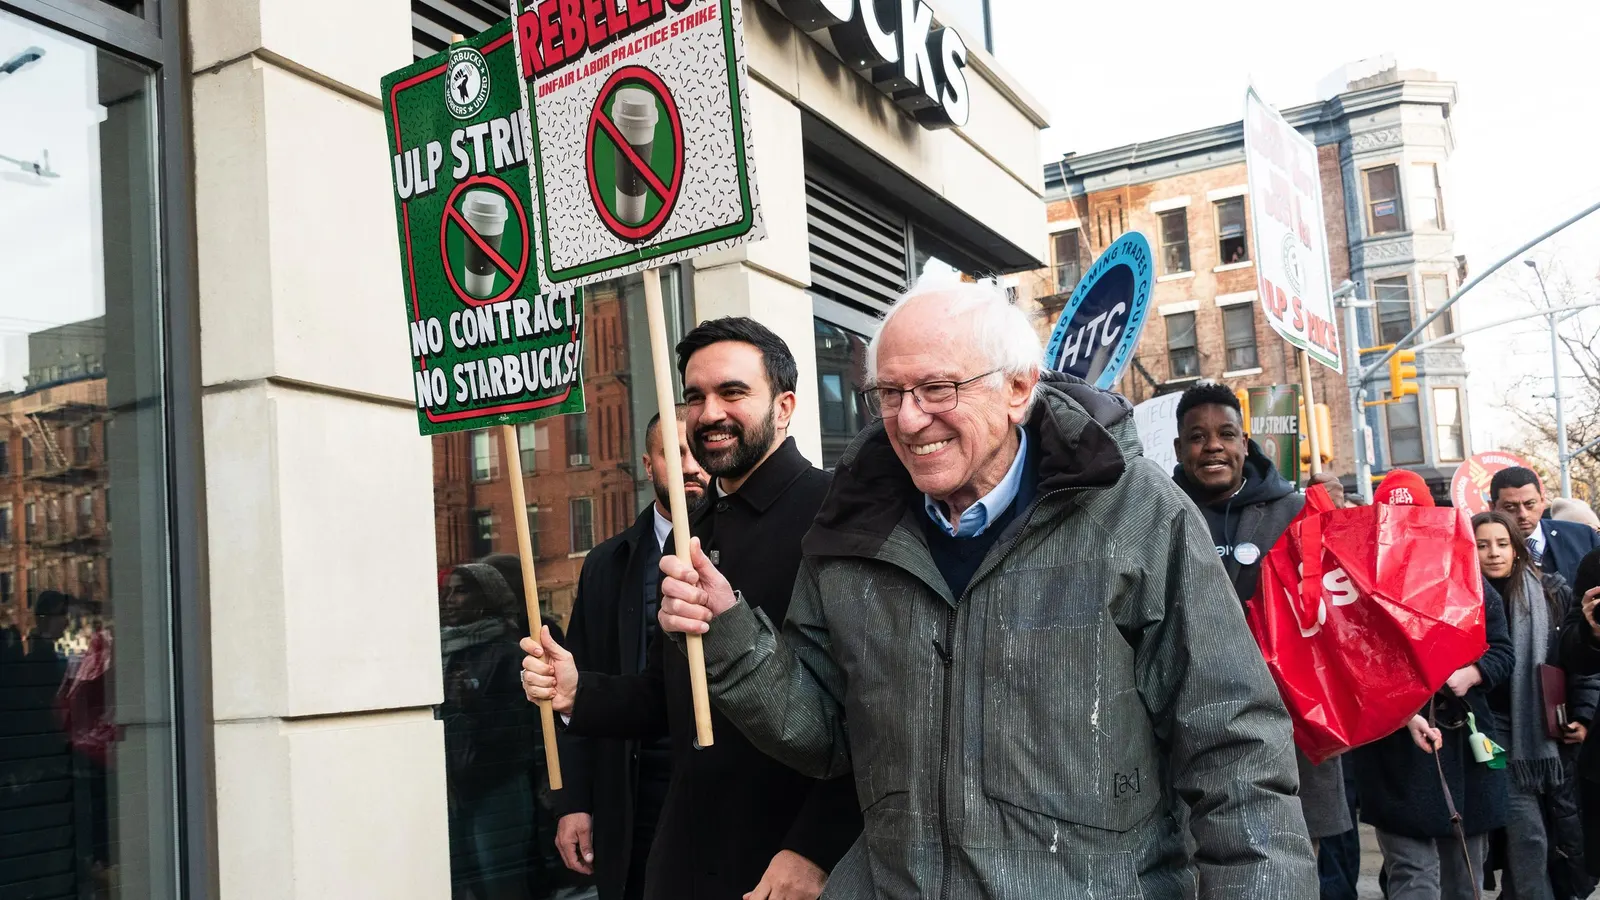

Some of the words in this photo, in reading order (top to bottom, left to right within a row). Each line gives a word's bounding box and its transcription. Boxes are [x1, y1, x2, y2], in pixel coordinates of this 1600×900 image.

[447, 51, 483, 76] STARBUCKS
[539, 70, 574, 98] UNFAIR
[576, 53, 610, 82] LABOR
[611, 27, 669, 65] PRACTICE
[670, 4, 717, 38] STRIKE
[446, 88, 468, 115] WORKERS
[473, 76, 488, 109] UNITED
[394, 141, 443, 200] ULP
[449, 109, 528, 180] STRI
[1071, 246, 1119, 307] GAMING
[1121, 242, 1148, 277] TRADES
[410, 318, 442, 357] NO
[448, 287, 581, 349] CONTRACT,
[1057, 301, 1126, 373] HTC
[1108, 281, 1147, 372] COUNCIL
[1260, 275, 1288, 322] ULP
[1291, 296, 1339, 356] SRIKE
[415, 367, 448, 409] NO
[453, 339, 580, 403] STARBUCKS!
[1251, 416, 1264, 435] ULP
[1265, 415, 1297, 434] STRIKE
